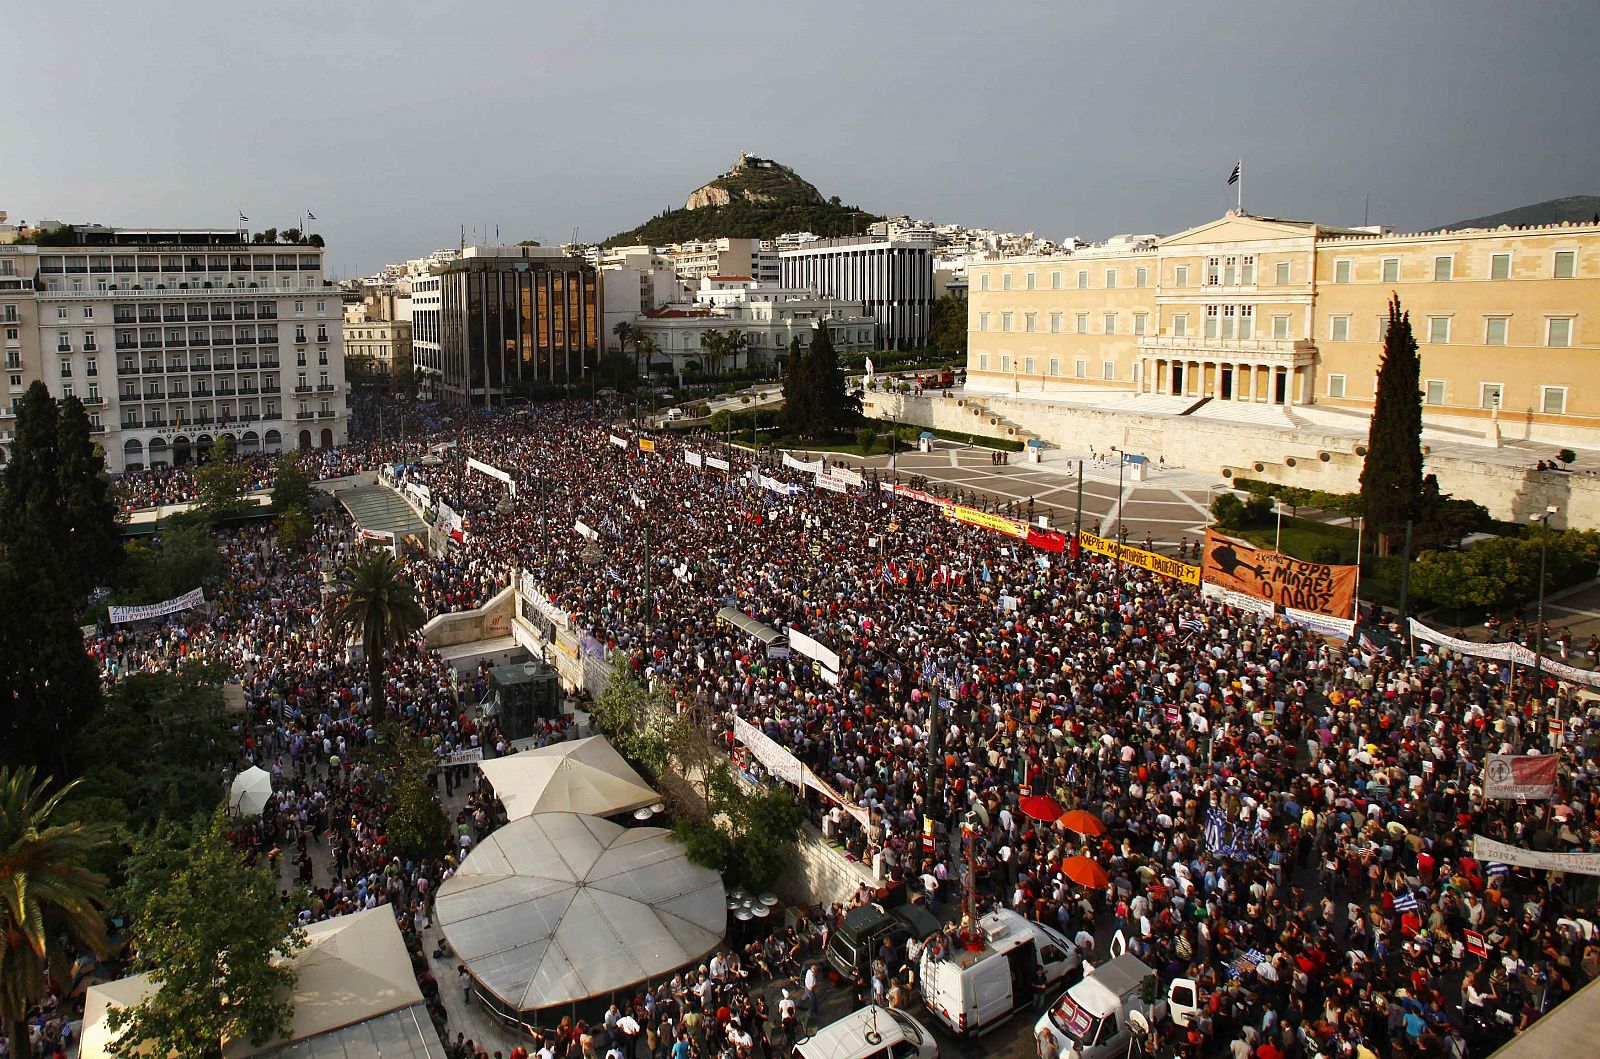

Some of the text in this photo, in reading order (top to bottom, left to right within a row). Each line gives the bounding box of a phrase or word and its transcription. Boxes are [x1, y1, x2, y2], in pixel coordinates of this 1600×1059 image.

[1283, 556, 1331, 580] ΤΩΡΑ
[1262, 580, 1274, 599] Ο
[1281, 585, 1334, 614] ΛΑΟΣ
